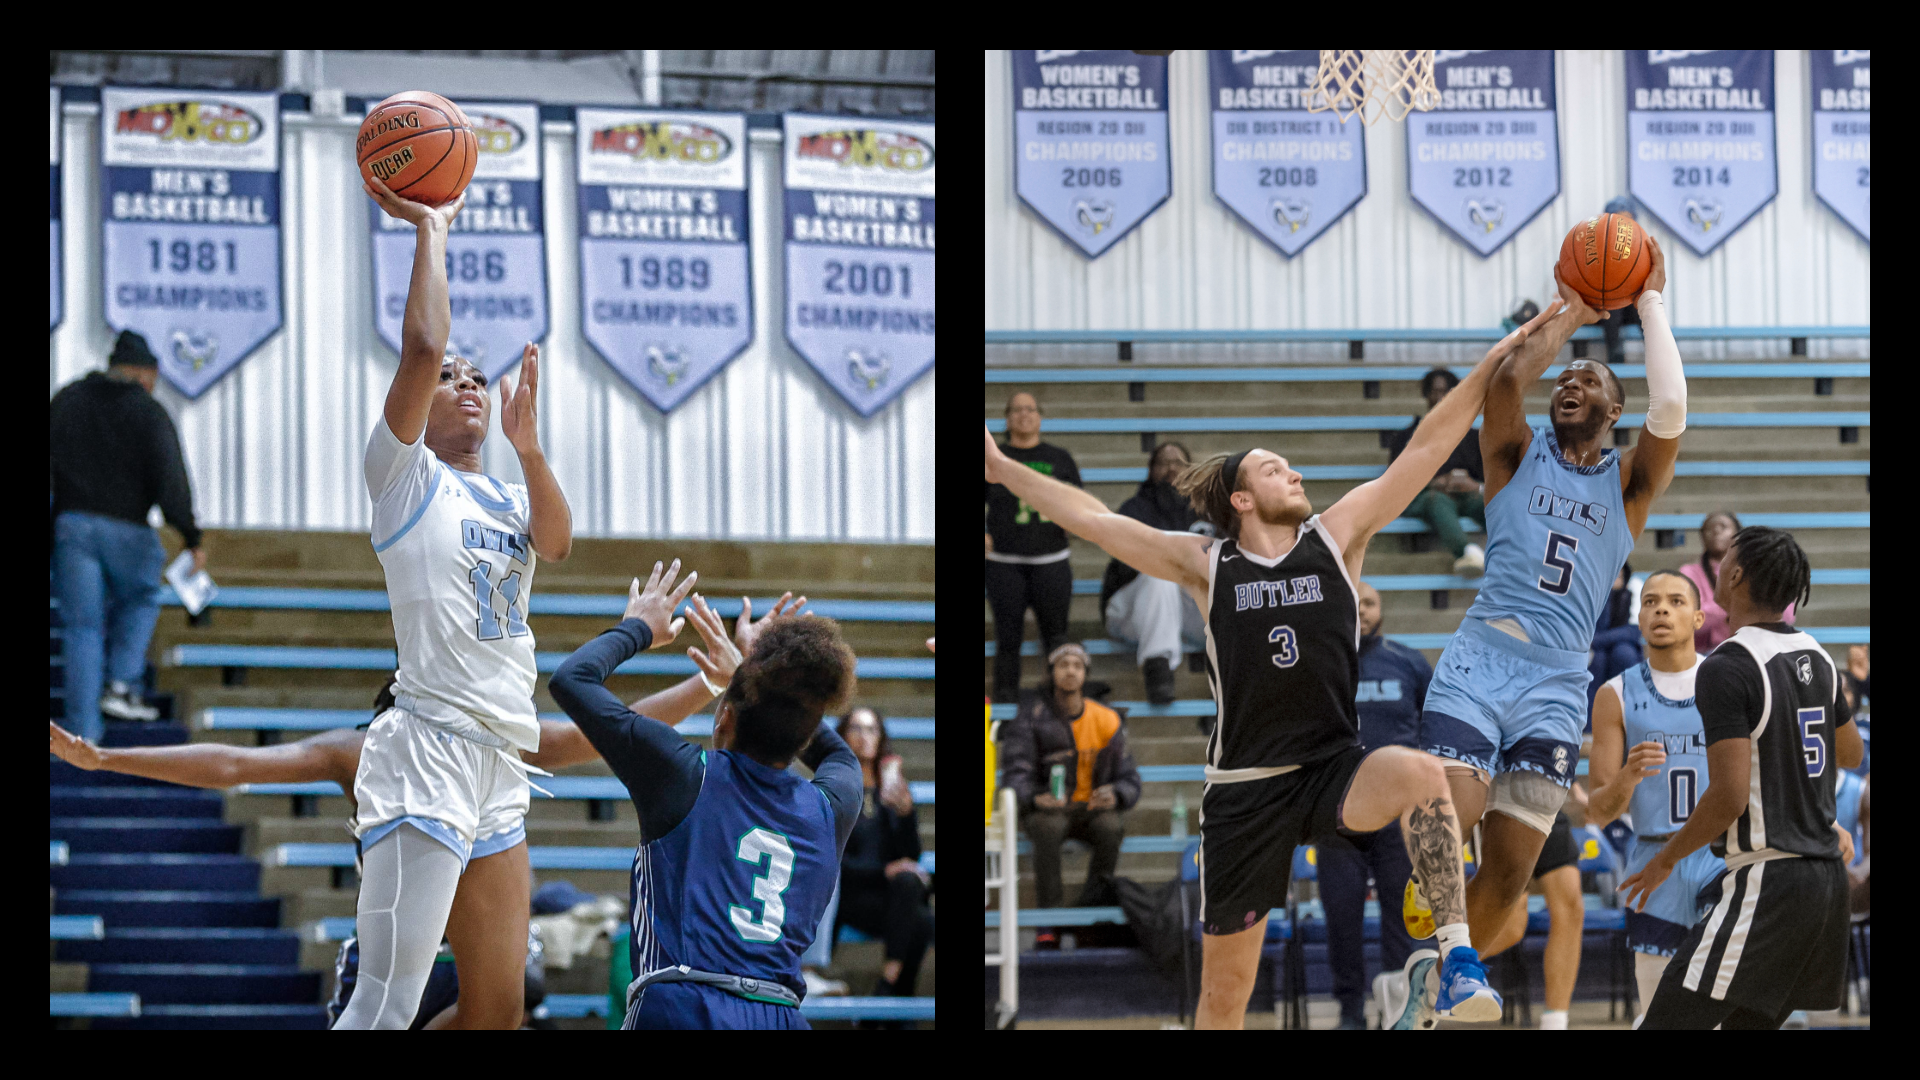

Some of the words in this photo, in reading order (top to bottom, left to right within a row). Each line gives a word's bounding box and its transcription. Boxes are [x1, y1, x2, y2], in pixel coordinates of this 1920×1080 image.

[1040, 65, 1140, 86] WOMEN'S
[1253, 65, 1319, 86] MEN'S
[1446, 66, 1513, 87] MEN'S
[1668, 66, 1733, 87] MEN'S
[1022, 87, 1158, 109] BASKETBALL
[1635, 88, 1765, 109] BASKETBALL
[1036, 121, 1092, 135] REGION
[1253, 121, 1321, 135] DISTRICT
[1025, 141, 1158, 161] CHAMPIONS
[1222, 141, 1352, 161] CHAMPIONS
[1418, 141, 1547, 161] CHAMPIONS
[1638, 141, 1764, 161] CHAMPIONS
[152, 170, 229, 196] MEN'S
[1062, 167, 1121, 187] 2006
[1259, 167, 1317, 187] 2008
[1453, 166, 1511, 187] 2012
[1672, 166, 1730, 187] 2014
[113, 191, 268, 222] BASKETBALL
[608, 188, 718, 213] WOMEN'S
[813, 192, 920, 221] WOMEN'S
[588, 211, 737, 241] BASKETBALL
[149, 239, 237, 272] 1981
[618, 256, 711, 290] 1989
[824, 261, 911, 296] 2001
[116, 284, 268, 311] CHAMPIONS
[593, 301, 738, 329] CHAMPIONS
[1528, 485, 1609, 536] OWLS
[461, 519, 529, 565] OWLS
[1538, 530, 1579, 596] 5
[469, 560, 529, 641] 11
[1235, 574, 1323, 612] BUTLER
[1268, 625, 1299, 669] 3
[1797, 706, 1826, 777] 5
[1668, 767, 1697, 826] 0
[728, 825, 797, 944] 3
